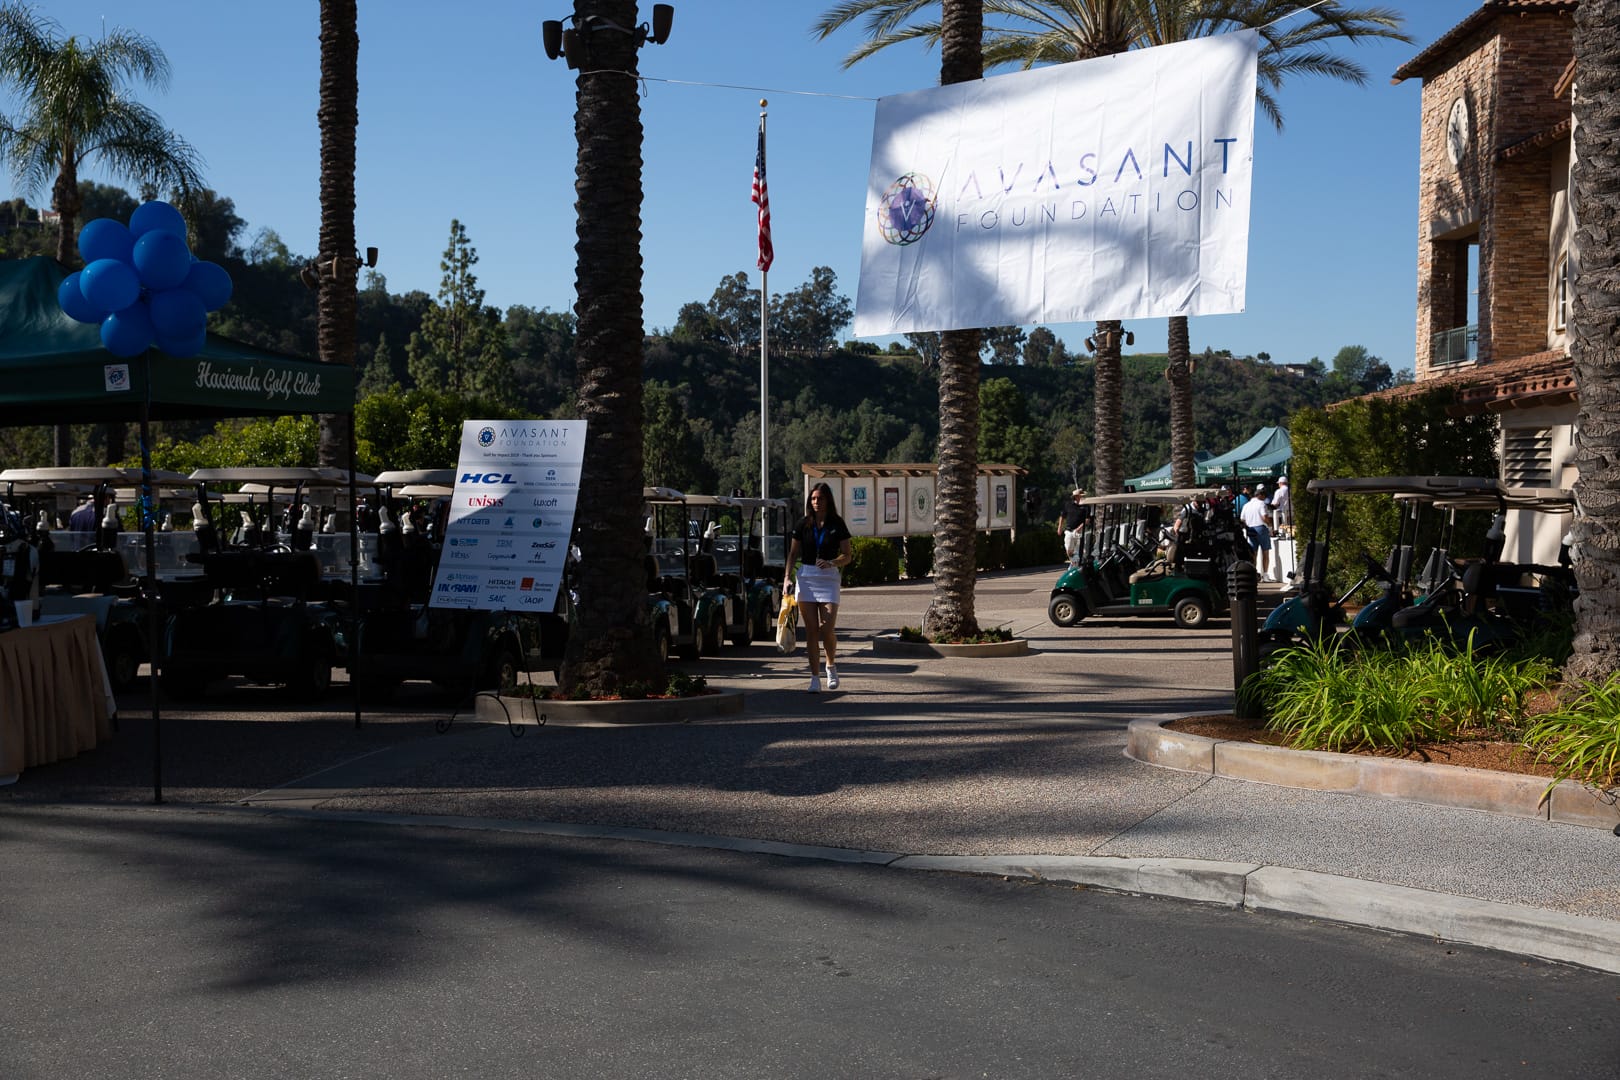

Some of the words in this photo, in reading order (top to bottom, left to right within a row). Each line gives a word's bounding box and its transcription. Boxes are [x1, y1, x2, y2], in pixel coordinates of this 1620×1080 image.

[957, 138, 1238, 202] AVASANT
[957, 188, 1233, 233] FOUNDATION
[195, 361, 261, 391] Hacienda
[263, 368, 292, 401] Golf
[293, 373, 321, 396] Club
[500, 428, 569, 438] AVASANT
[460, 473, 517, 484] HCL
[487, 594, 506, 603] SAIC
